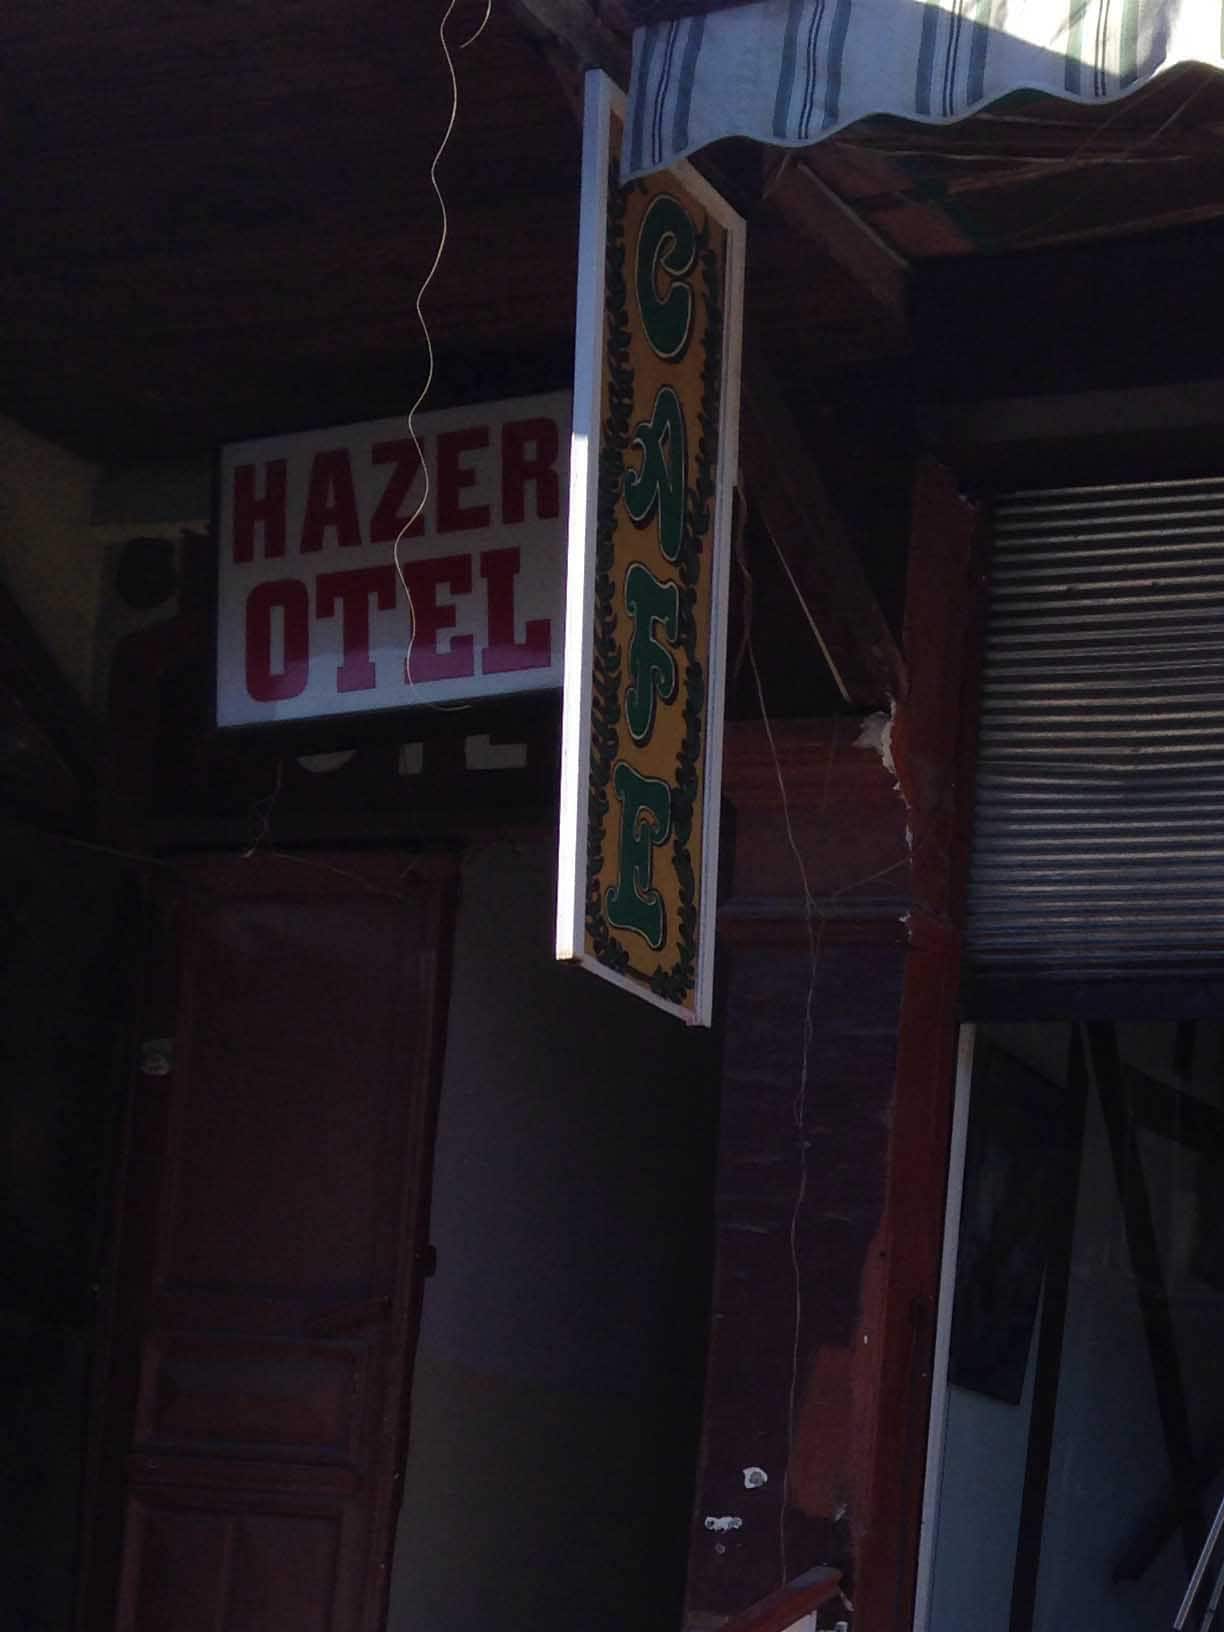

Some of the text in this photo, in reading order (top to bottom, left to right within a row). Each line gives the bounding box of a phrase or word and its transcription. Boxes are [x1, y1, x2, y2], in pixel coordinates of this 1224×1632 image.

[232, 415, 560, 564] HAZER
[245, 547, 552, 703] OTEL
[602, 192, 697, 952] CAFE
